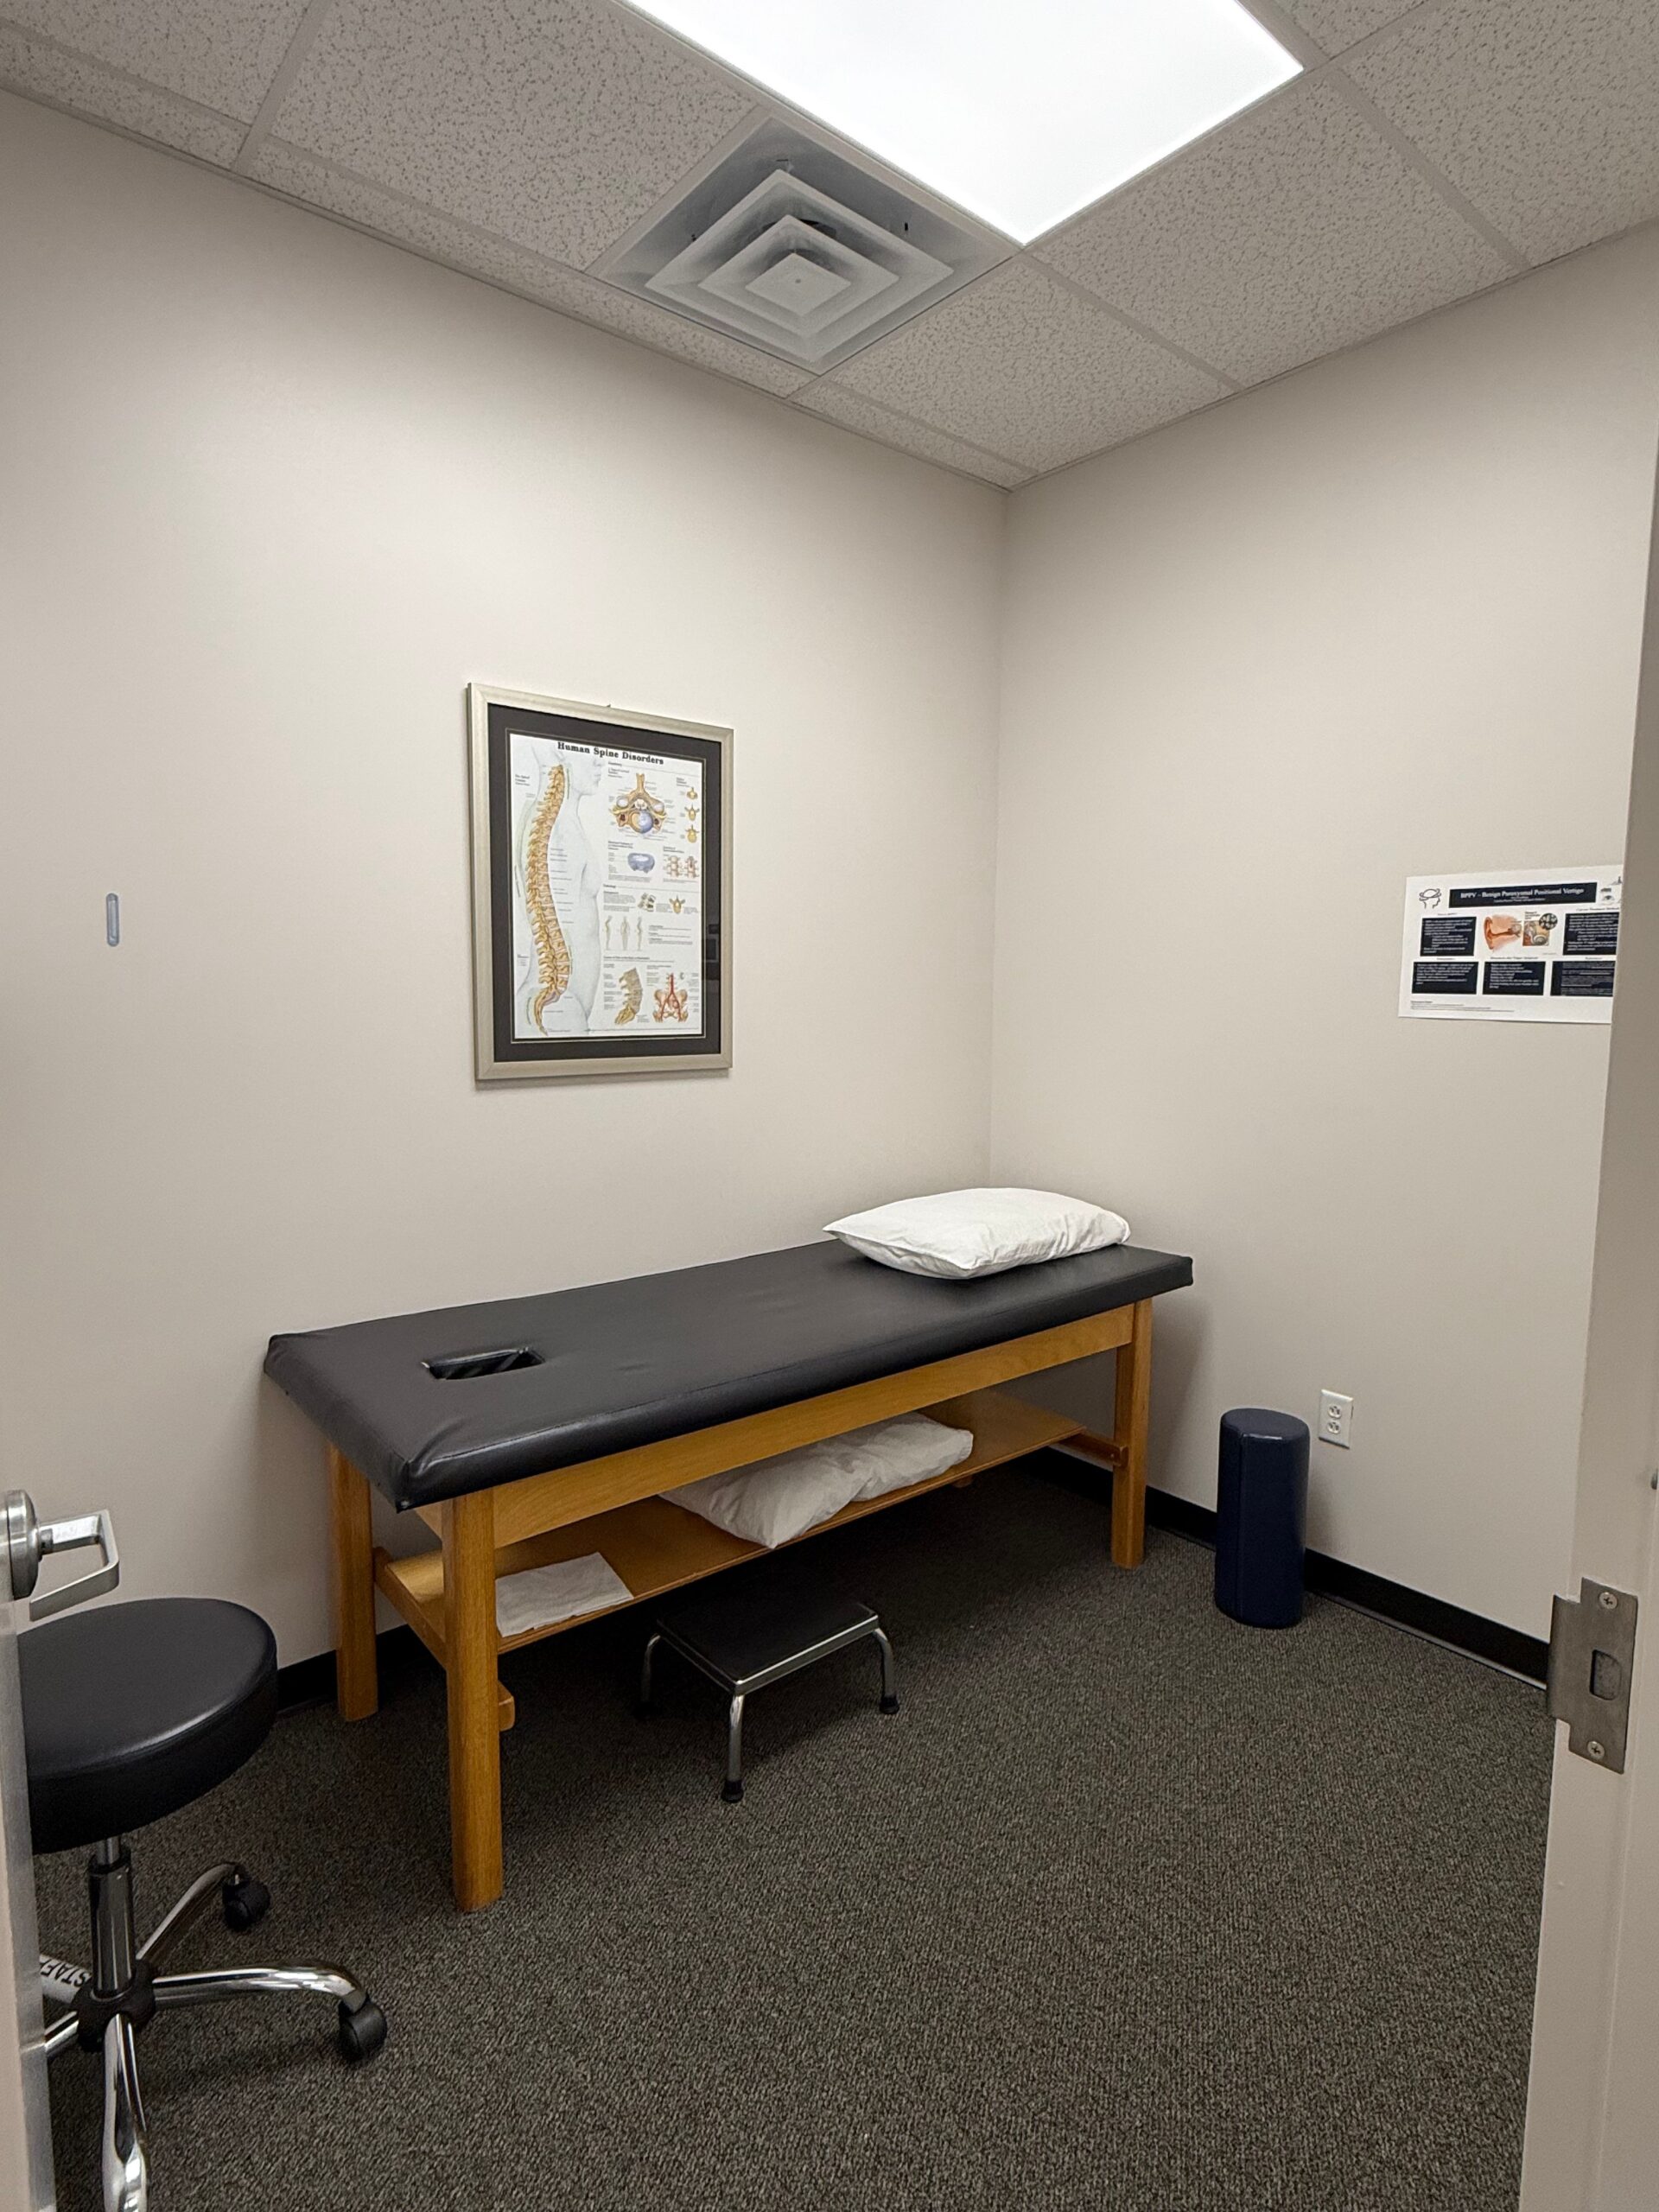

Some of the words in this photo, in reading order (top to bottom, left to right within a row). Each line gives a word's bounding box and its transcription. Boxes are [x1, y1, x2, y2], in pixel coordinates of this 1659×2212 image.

[557, 741, 590, 753] Human
[594, 747, 619, 759] Spine
[622, 751, 664, 765] Disorders
[1563, 887, 1585, 895] Vertigo
